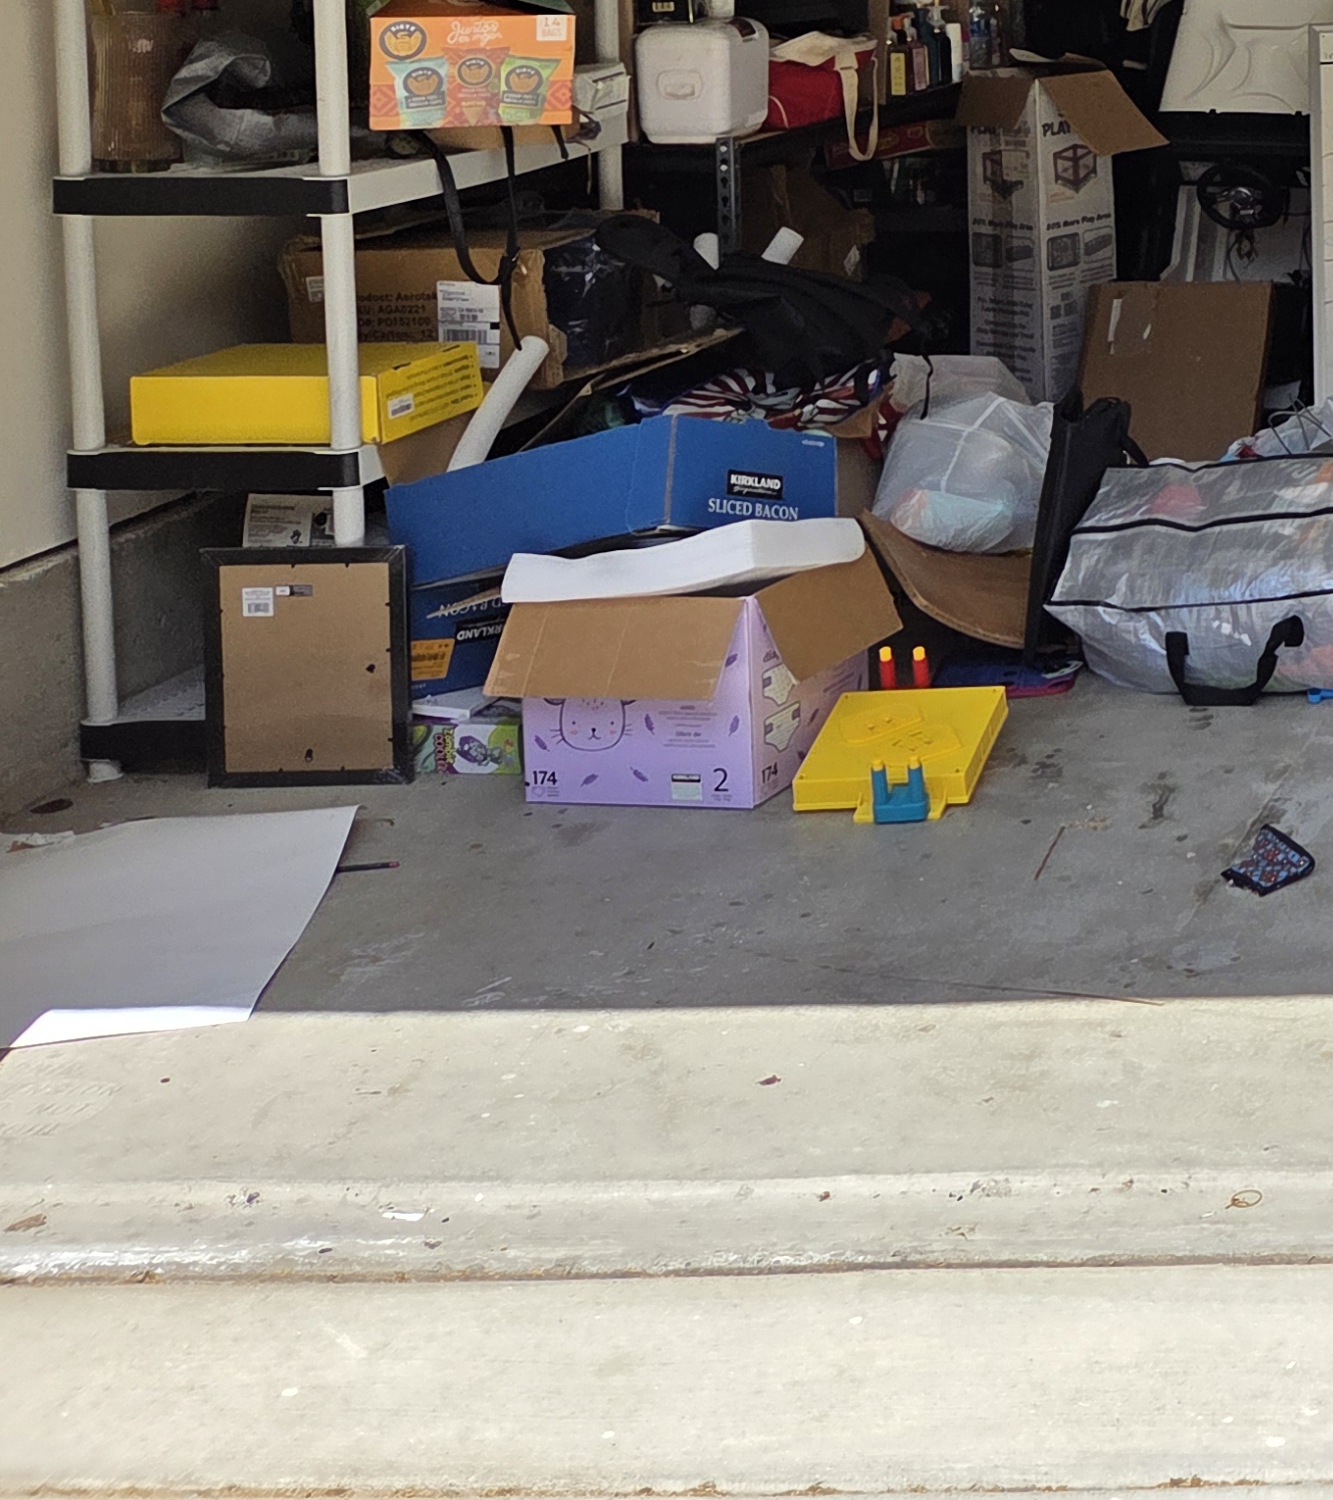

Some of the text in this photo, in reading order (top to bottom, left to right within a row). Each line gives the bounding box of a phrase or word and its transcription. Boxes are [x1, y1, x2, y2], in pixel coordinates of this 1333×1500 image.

[730, 473, 782, 490] KIRKLAND
[707, 497, 799, 521] SLICED BACON
[532, 770, 558, 786] 174
[712, 767, 730, 792] 2
[761, 762, 778, 784] 174
